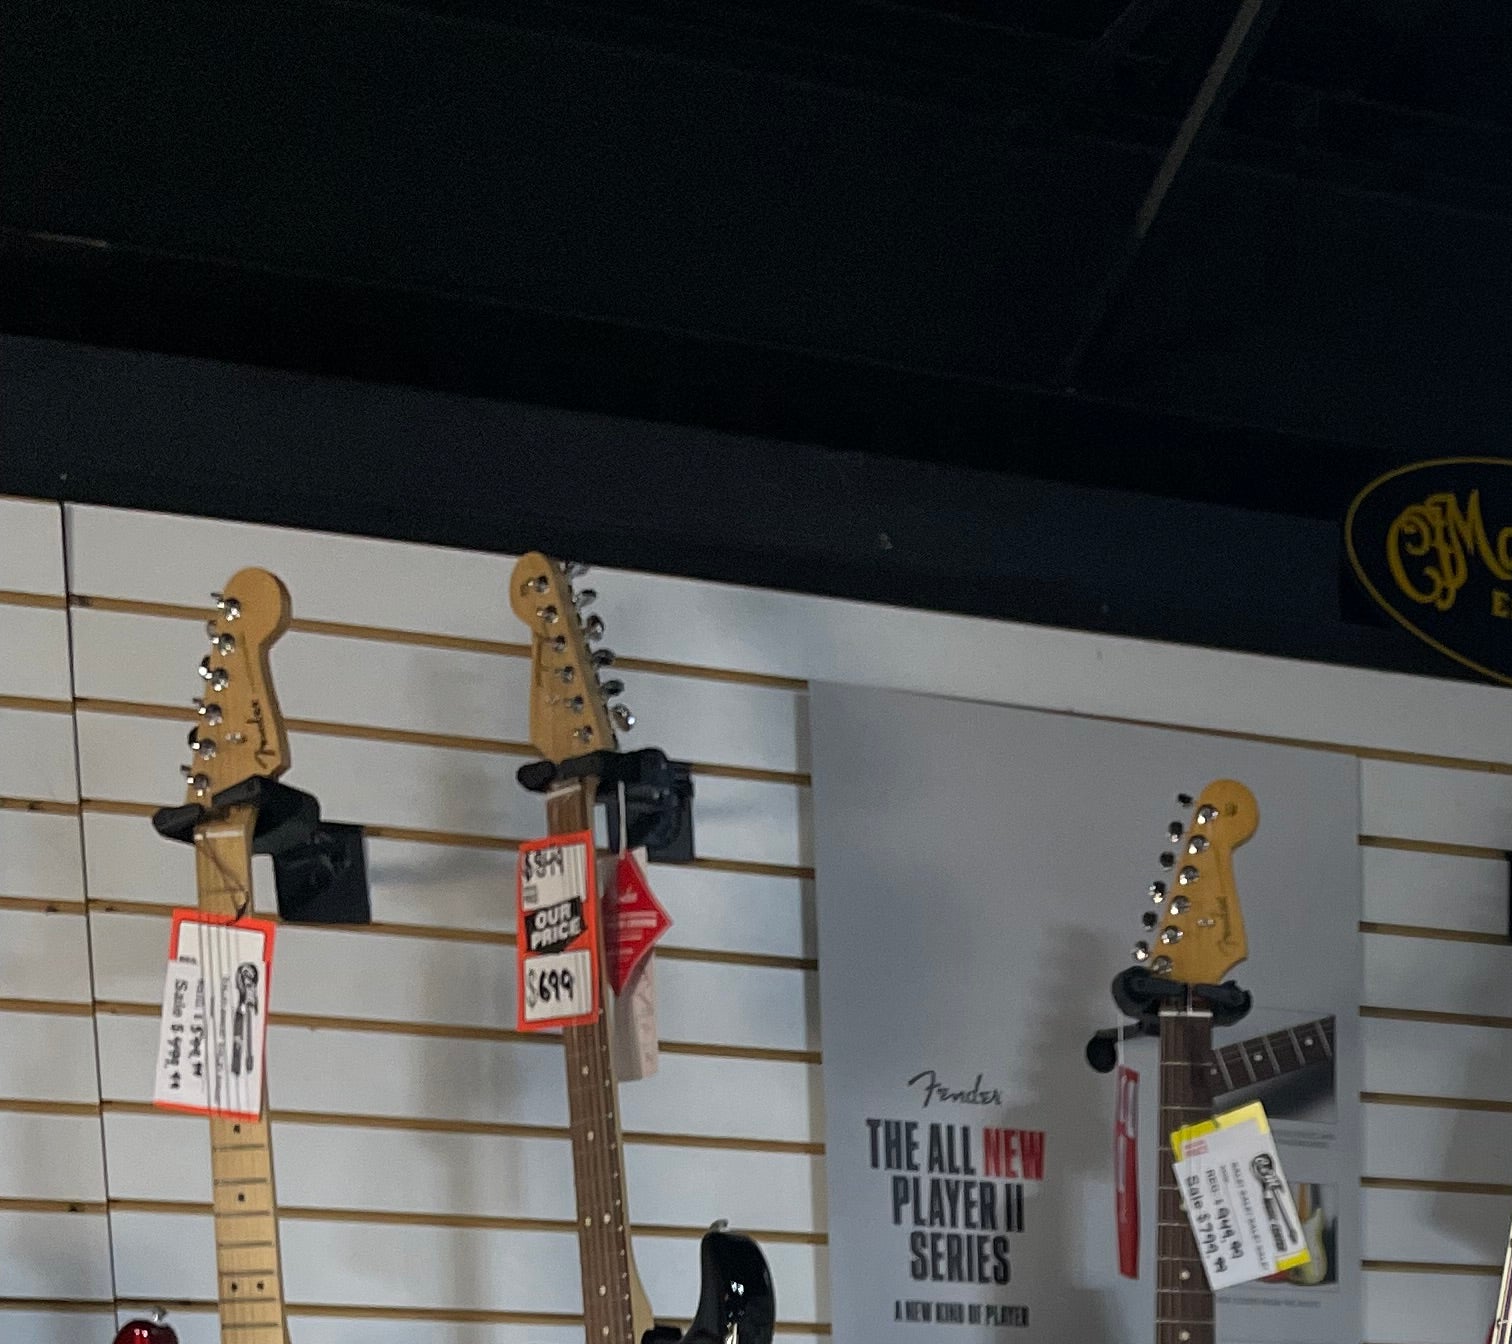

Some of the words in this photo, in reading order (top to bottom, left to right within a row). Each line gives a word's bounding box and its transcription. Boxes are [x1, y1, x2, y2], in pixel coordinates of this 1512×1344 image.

[530, 916, 582, 951] PRICE
[533, 903, 573, 930] OUR
[172, 978, 188, 1018] Sale
[527, 966, 575, 1009] $699
[907, 1069, 1003, 1109] Fender
[865, 1117, 921, 1172] THE
[928, 1121, 977, 1176] ALL
[982, 1125, 1046, 1182] NEW
[891, 1175, 998, 1231] PLAYER
[1004, 1182, 1025, 1233] II
[1186, 1174, 1204, 1210] Sale
[909, 1230, 1011, 1286] SERIES
[905, 1301, 933, 1323] NEW
